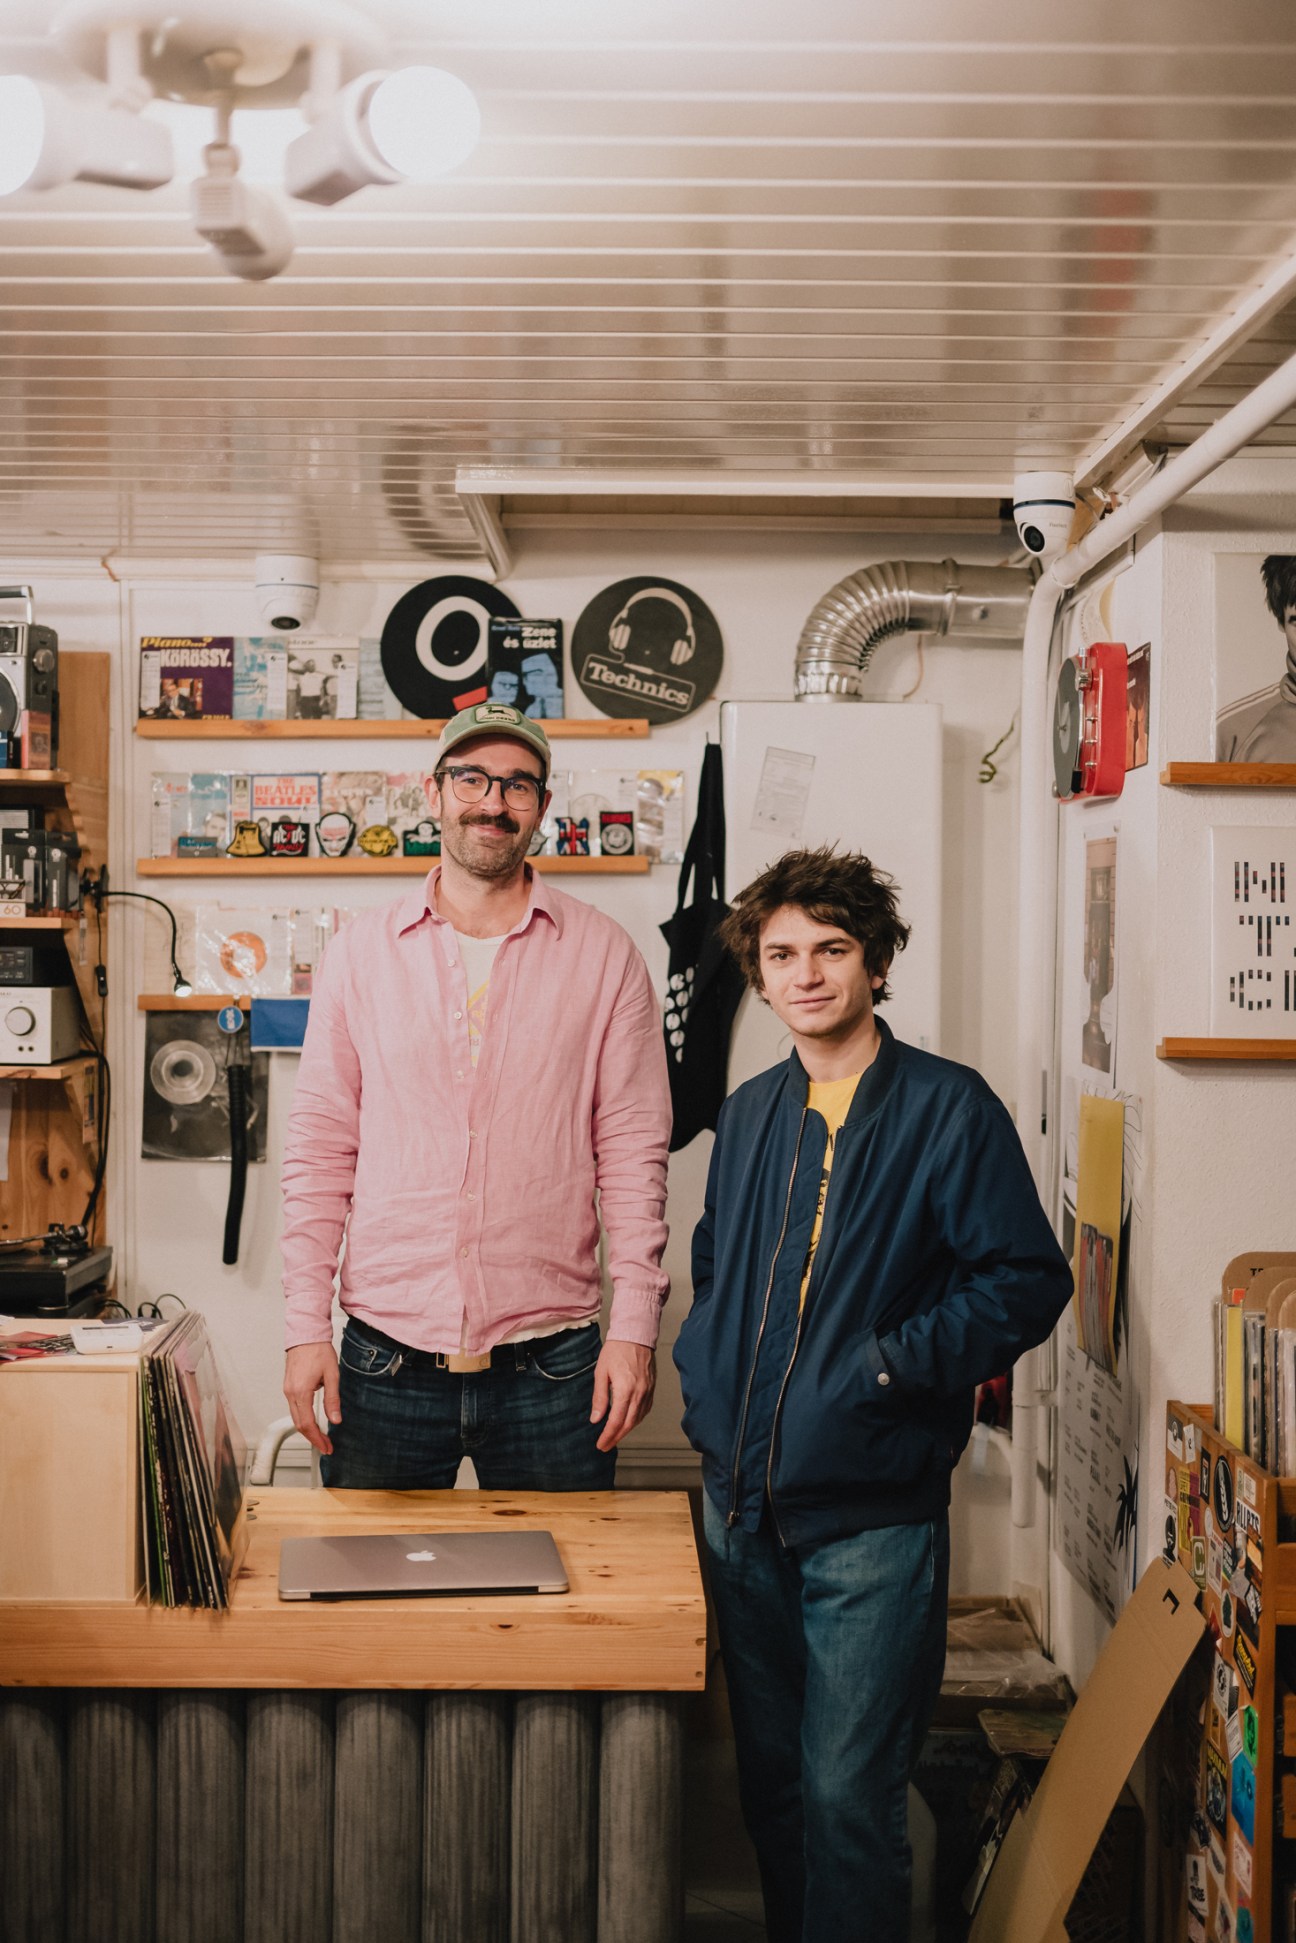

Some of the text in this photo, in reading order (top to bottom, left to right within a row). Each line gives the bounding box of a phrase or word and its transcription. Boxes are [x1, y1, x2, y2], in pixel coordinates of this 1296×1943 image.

[521, 627, 557, 638] Zene
[588, 661, 690, 705] Technics
[255, 785, 317, 796] BEATLES
